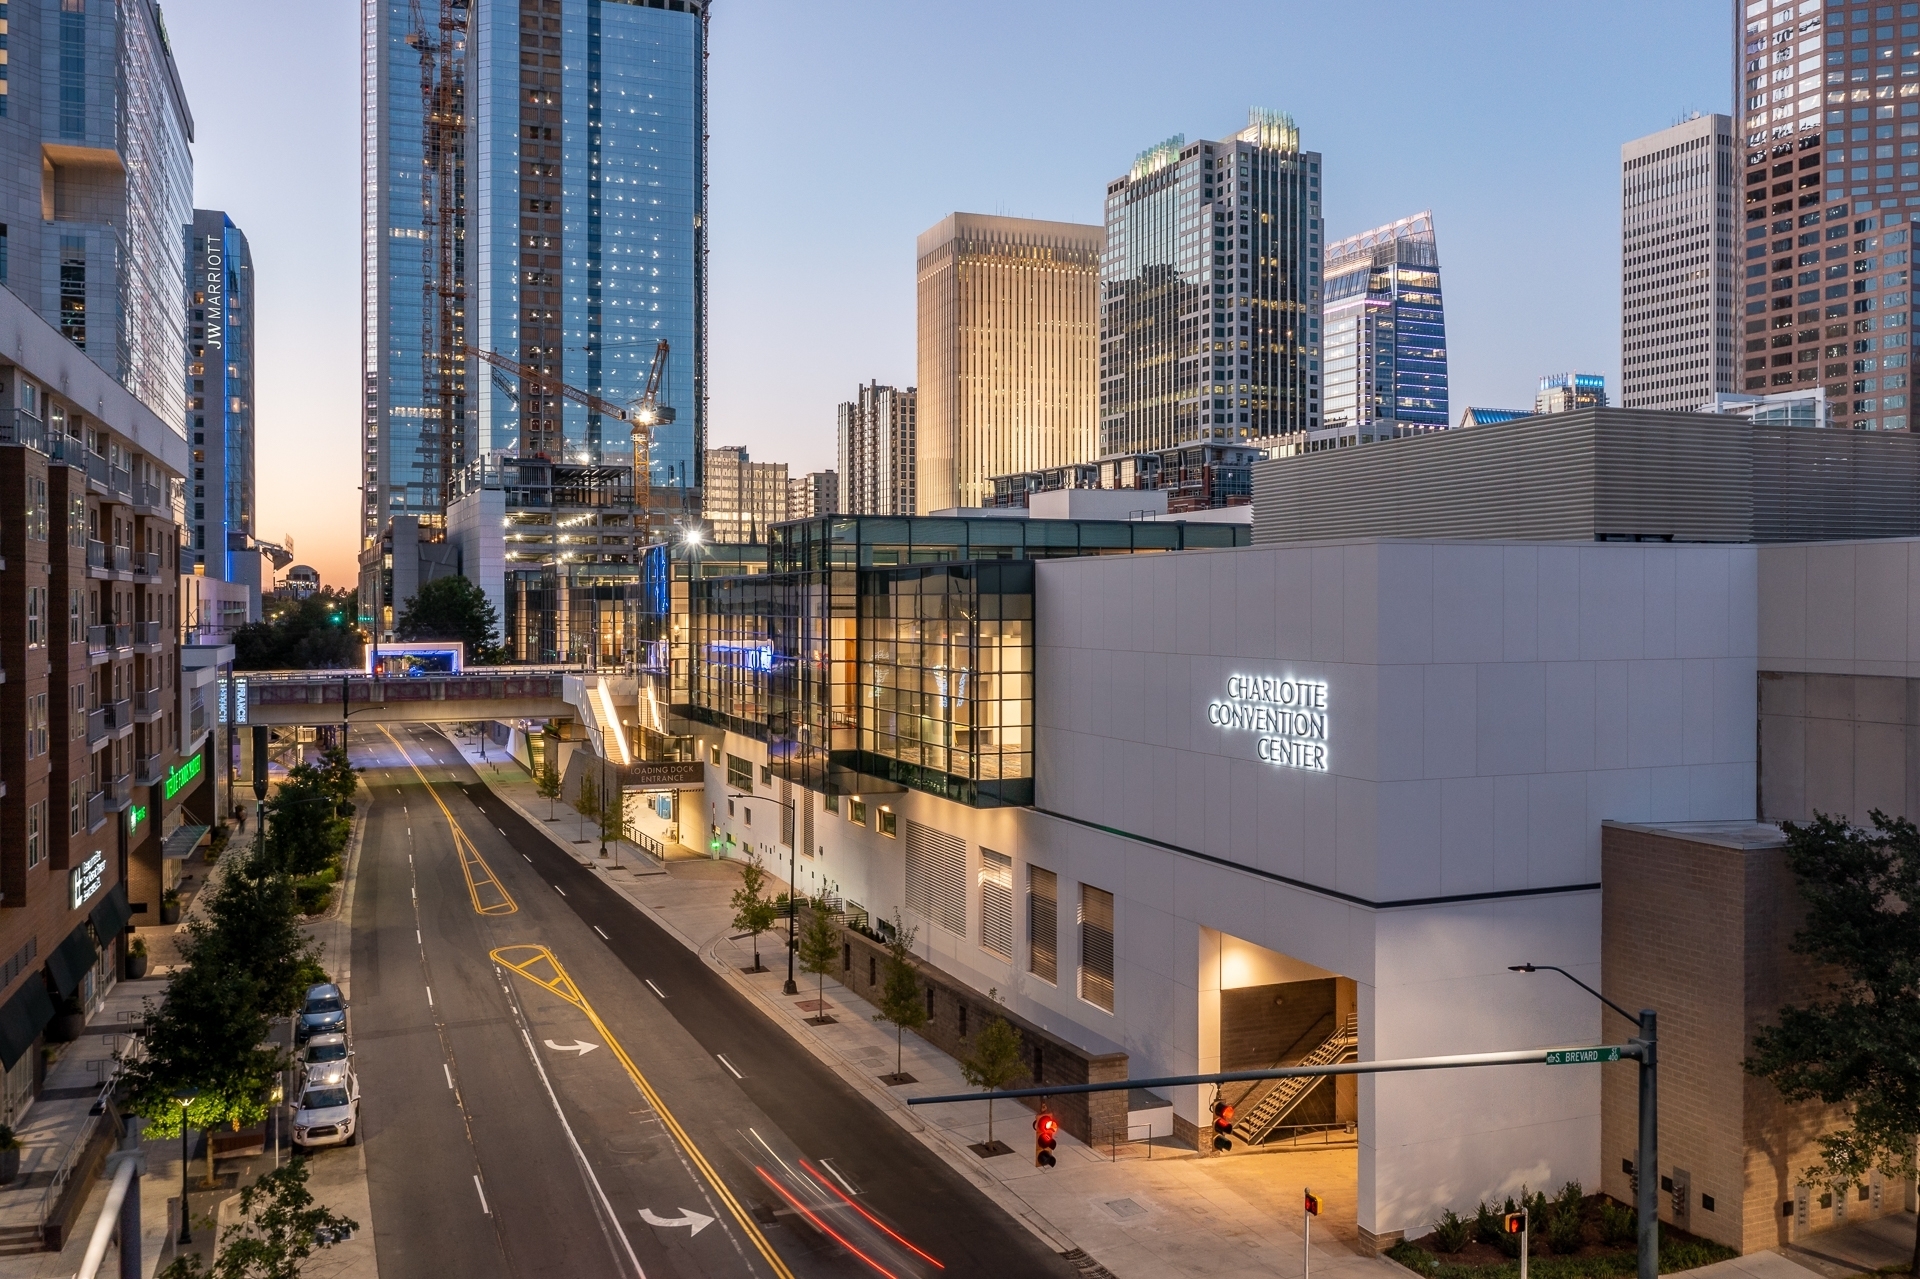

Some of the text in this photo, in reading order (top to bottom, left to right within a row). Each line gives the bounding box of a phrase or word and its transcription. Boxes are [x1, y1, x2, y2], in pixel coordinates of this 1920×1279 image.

[207, 234, 222, 349] JW MARRIOTT
[236, 687, 246, 723] FRANCIS
[1227, 676, 1326, 708] CHARLOTTE
[1207, 703, 1325, 739] CONVENTION
[1257, 738, 1325, 769] CENTER
[630, 765, 694, 775] LOADING DOCK
[641, 774, 684, 783] ENTRANCE
[1565, 1050, 1598, 1063] BREVARD
